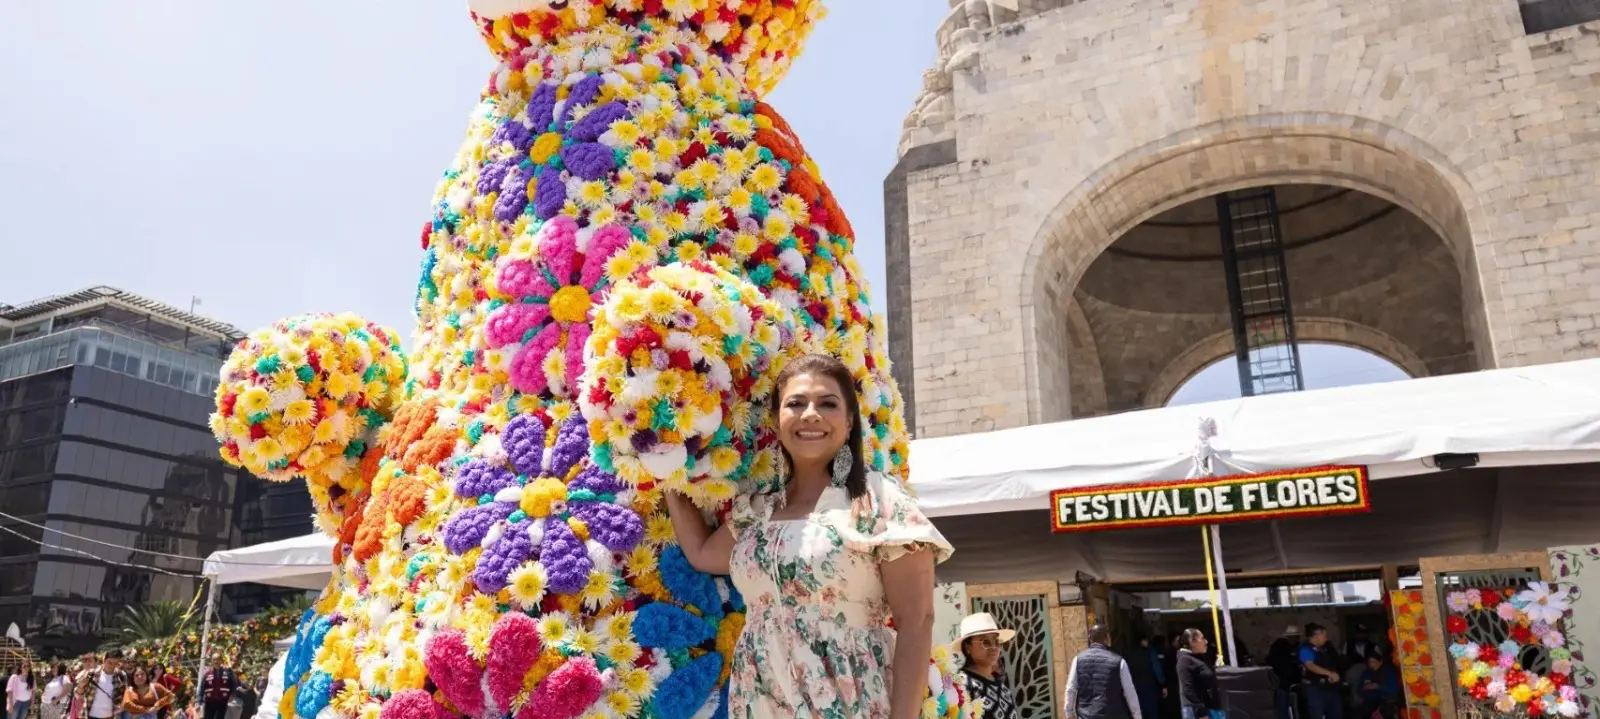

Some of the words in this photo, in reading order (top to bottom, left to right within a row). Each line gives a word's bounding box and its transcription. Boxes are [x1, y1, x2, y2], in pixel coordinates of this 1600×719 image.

[1059, 488, 1189, 523] FESTIVAL
[1194, 485, 1233, 514] DE
[1243, 475, 1357, 511] FLORES
